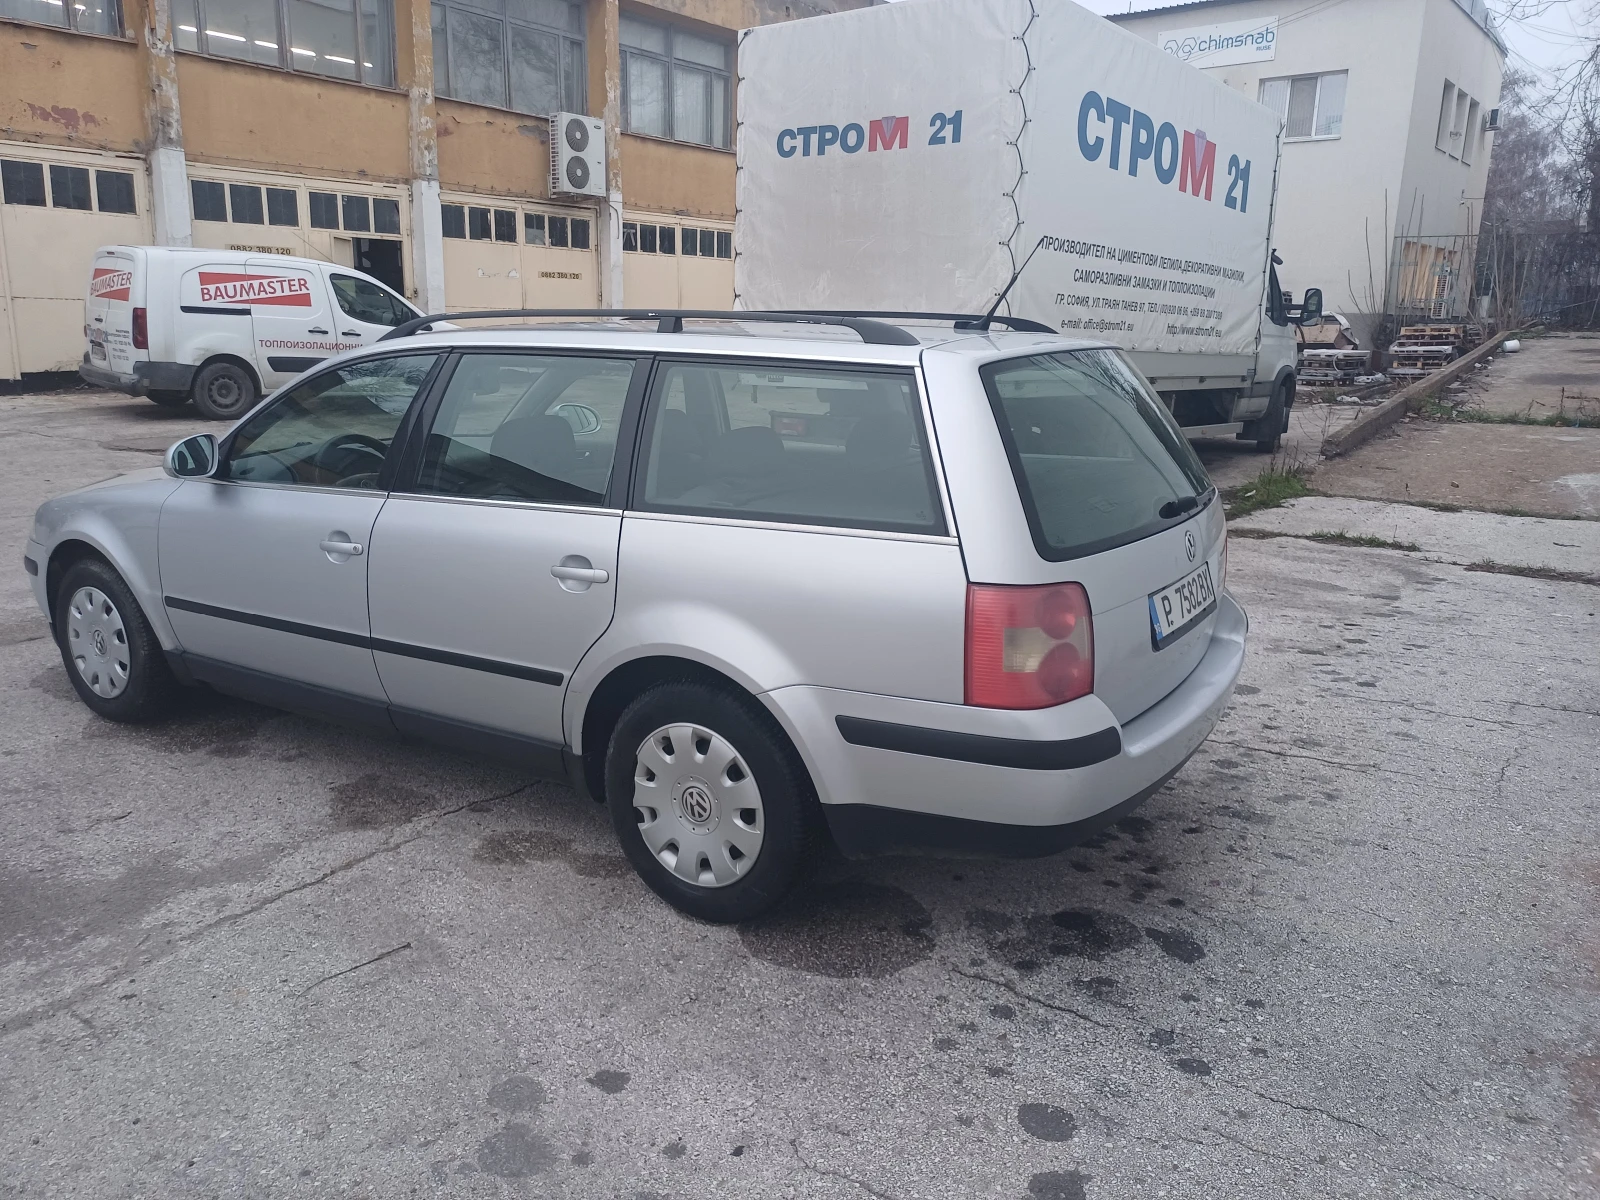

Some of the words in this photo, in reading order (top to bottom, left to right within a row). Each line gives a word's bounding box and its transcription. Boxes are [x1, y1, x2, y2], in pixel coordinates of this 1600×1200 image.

[1198, 26, 1275, 52] chimsnab
[776, 115, 909, 159] СТРОМ
[927, 109, 963, 146] 21
[1077, 90, 1217, 202] СТРОМ
[1224, 153, 1252, 214] 21
[276, 247, 291, 255] 120
[1041, 235, 1106, 259] ПРОИЗВОДИТЕЛ
[1106, 246, 1116, 261] НА
[1117, 248, 1158, 267] ЦИМЕНТОВИ
[90, 271, 133, 296] BAUMASTER
[200, 277, 310, 301] BAUMASTER
[1073, 268, 1132, 288] САМОРАЗЛИВНИ
[1132, 276, 1161, 291] ЗАМАЗКИ
[1161, 279, 1168, 292] И
[1168, 280, 1216, 300] ТОПЛОИЗОЛАЦИИ
[1055, 293, 1065, 305] ГР.
[1066, 294, 1090, 309] СОФИЯ,
[1120, 300, 1138, 312] ТАНЕВ
[1061, 318, 1082, 330] e-mail:
[1083, 318, 1135, 333] office@strom21.eu
